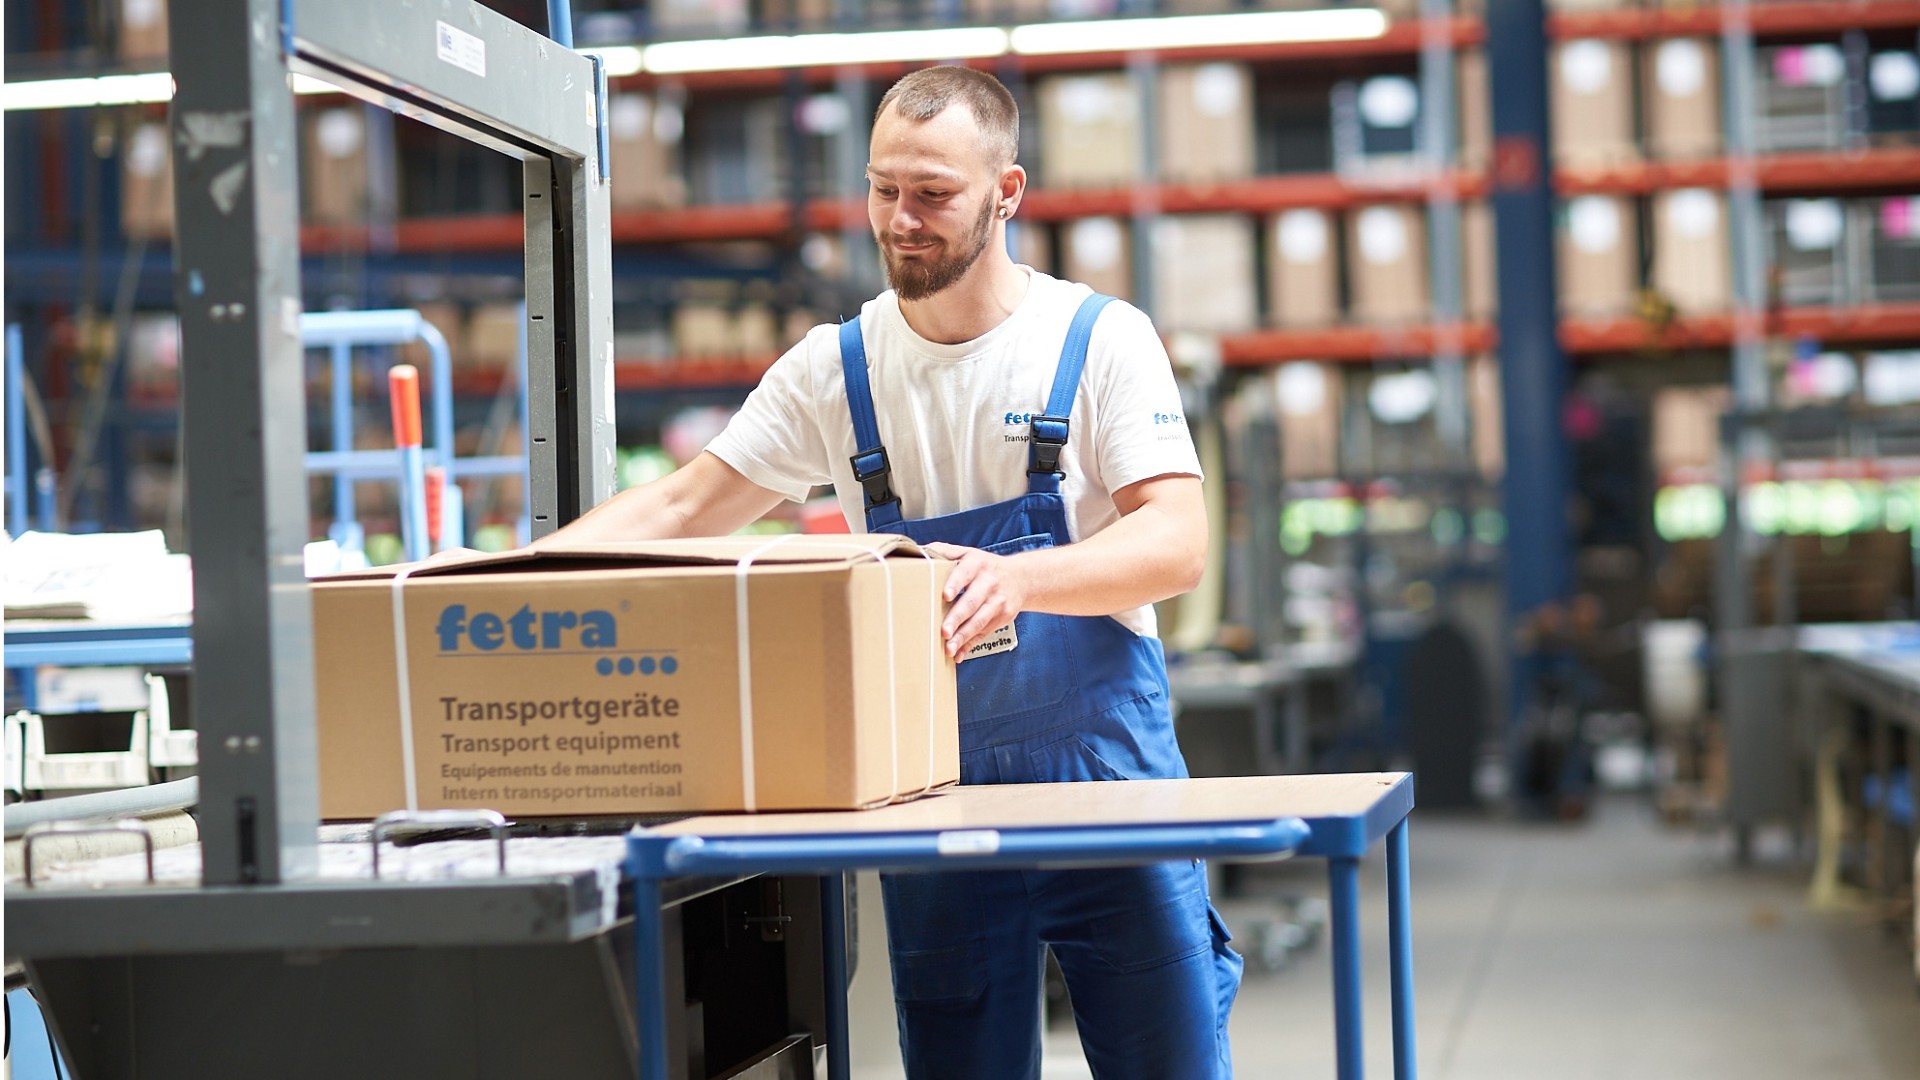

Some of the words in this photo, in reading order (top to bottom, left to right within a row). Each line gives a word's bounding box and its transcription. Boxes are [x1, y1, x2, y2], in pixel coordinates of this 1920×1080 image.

[1004, 434, 1030, 443] Transp
[435, 602, 618, 651] fetra
[440, 692, 680, 726] Transportgeräte
[441, 733, 550, 757] Transport
[556, 730, 681, 755] equipment
[441, 762, 547, 782] Equipements
[551, 761, 571, 777] de
[575, 759, 682, 777] manutention
[442, 785, 498, 801] Intern
[503, 781, 682, 802] transportmateriaal
